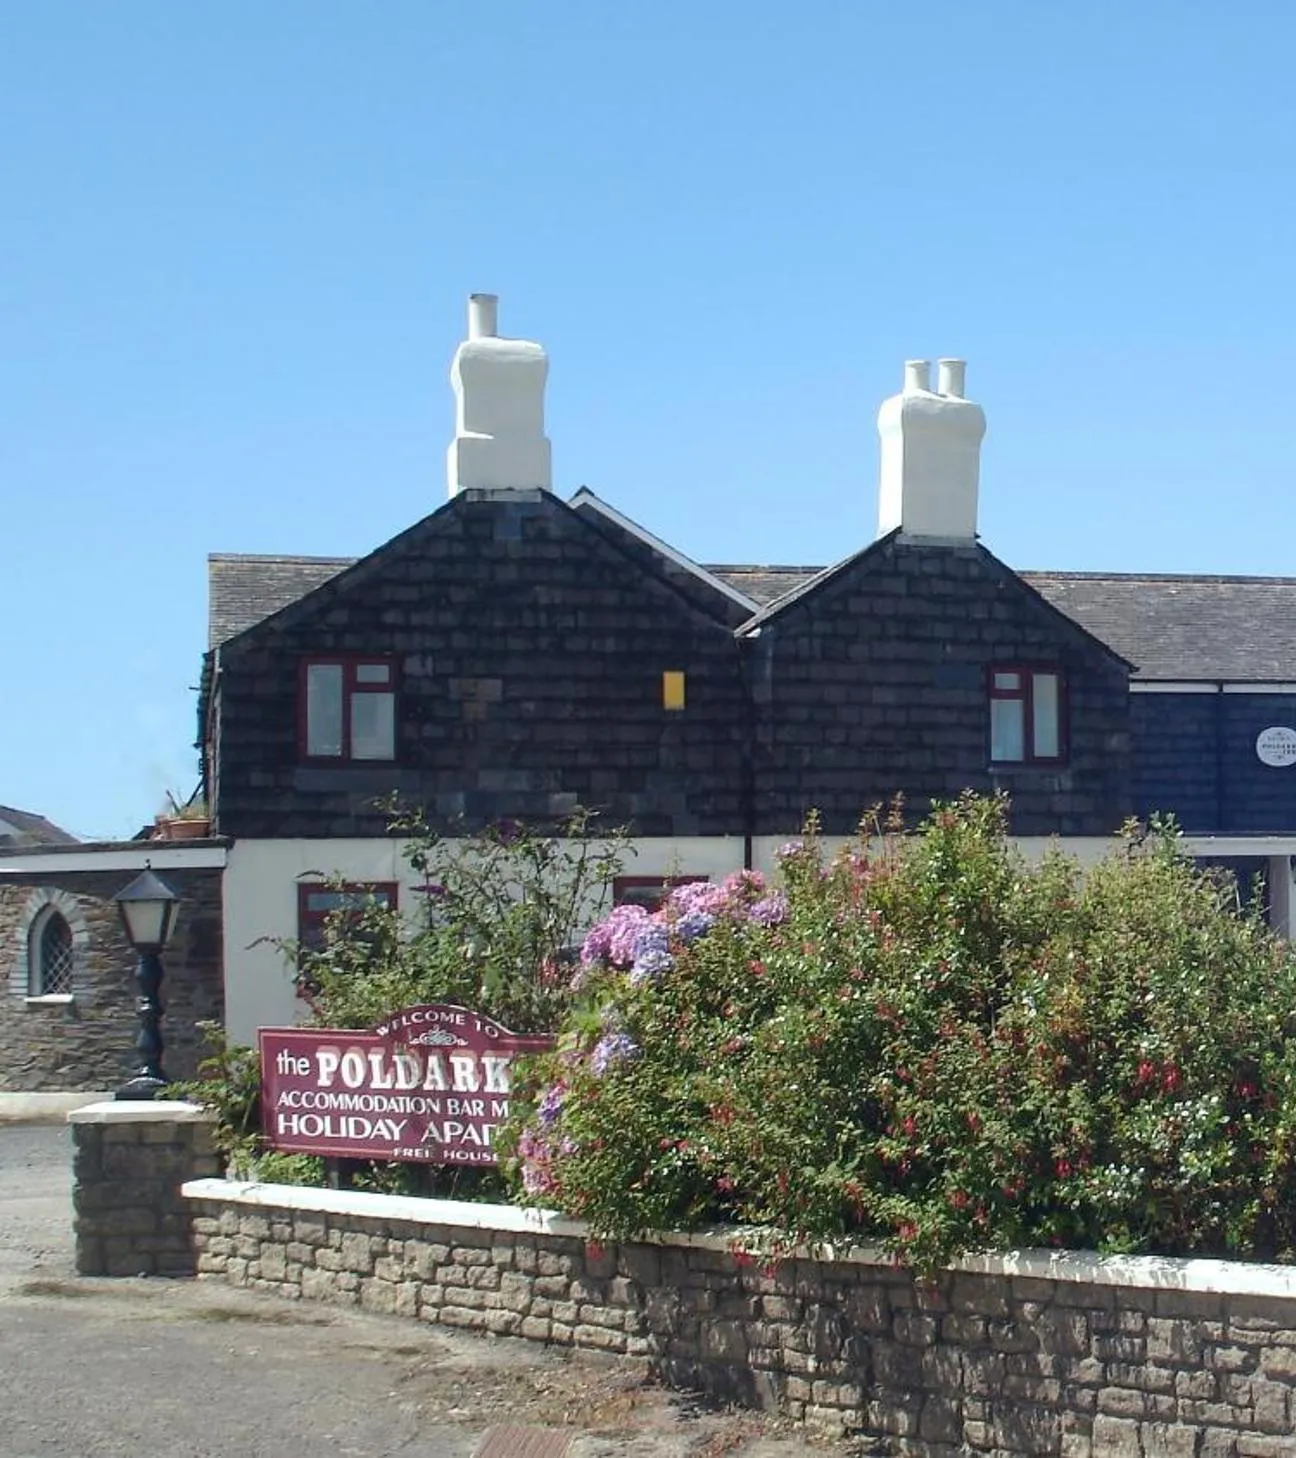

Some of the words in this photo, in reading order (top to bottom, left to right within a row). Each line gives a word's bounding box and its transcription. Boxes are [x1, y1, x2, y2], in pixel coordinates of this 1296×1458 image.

[376, 1010, 465, 1036] WELCOME
[475, 1020, 499, 1038] TO
[276, 1048, 310, 1076] the
[315, 1048, 510, 1094] POLDARK
[277, 1090, 441, 1115] ACCOMMODATION
[447, 1098, 484, 1117] BAR
[277, 1113, 407, 1142] HOLIDAY
